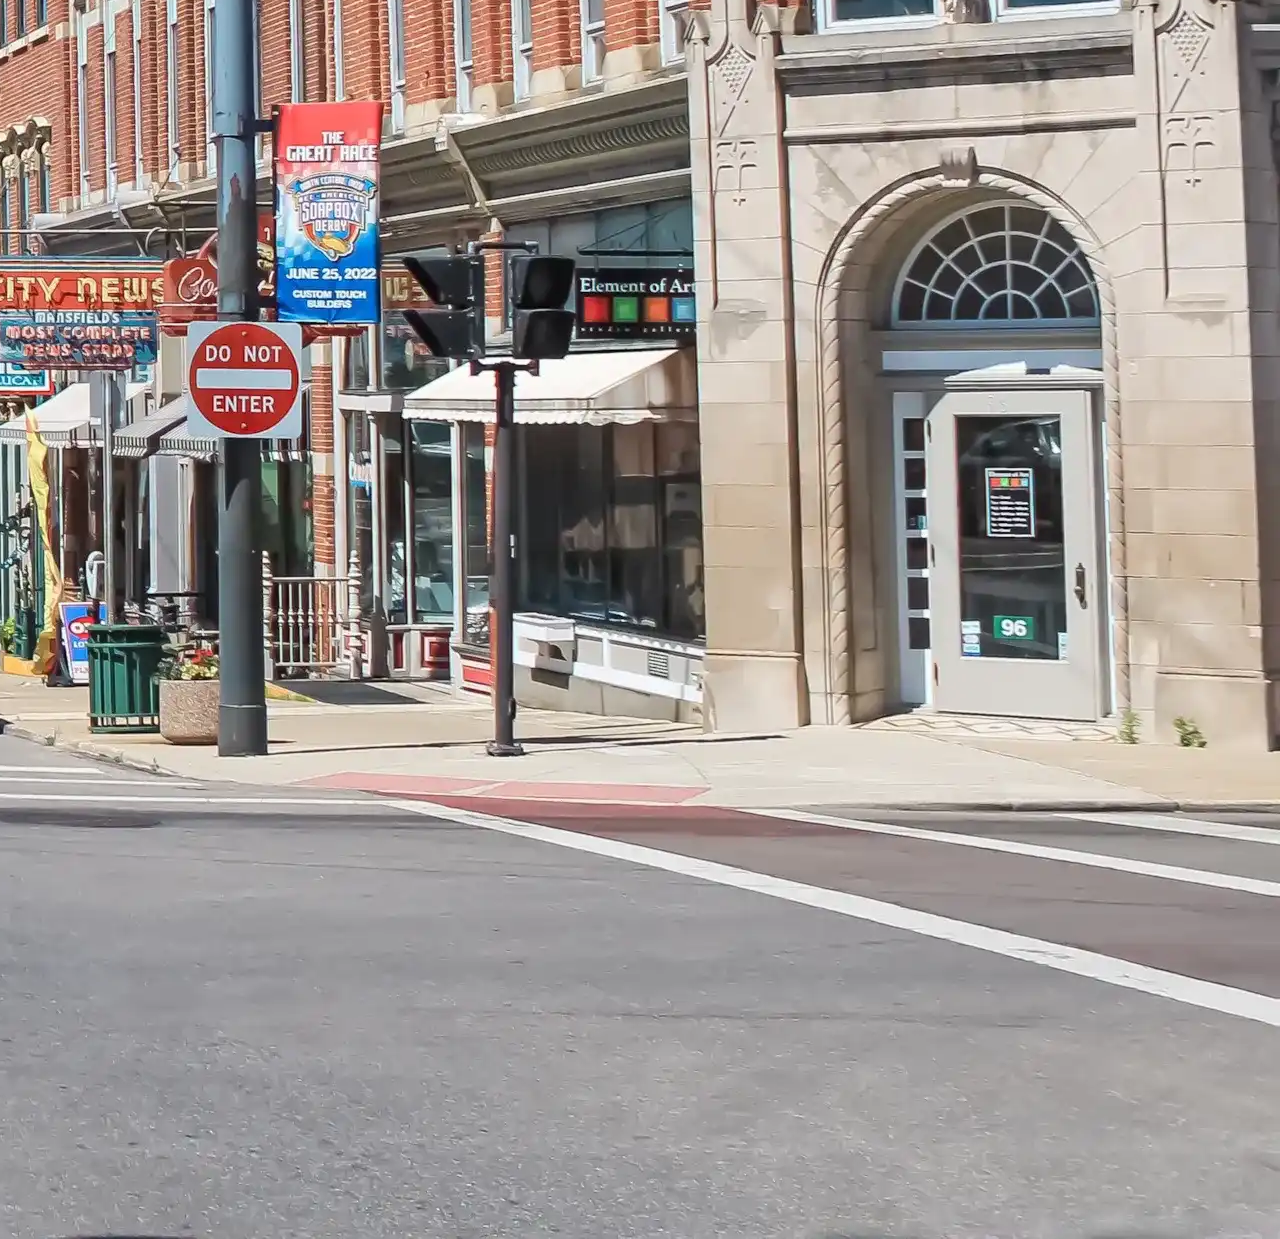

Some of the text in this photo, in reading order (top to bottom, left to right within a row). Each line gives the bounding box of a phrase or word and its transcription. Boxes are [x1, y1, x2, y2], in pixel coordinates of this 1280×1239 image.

[321, 131, 345, 144] THE
[286, 145, 378, 161] GREAT RACE
[315, 220, 348, 232] DERBY
[286, 268, 377, 281] JUNE 25, 2022
[579, 277, 697, 293] Element of Art
[292, 290, 367, 300] CUSTOM TOUCH
[306, 299, 353, 309] BUILDERS
[35, 311, 121, 324] MANSFIELD'S
[5, 325, 152, 340] MOST COMPLETE
[205, 345, 282, 363] DO NOT
[212, 395, 275, 414] ENTER
[1000, 619, 1028, 637] 96
